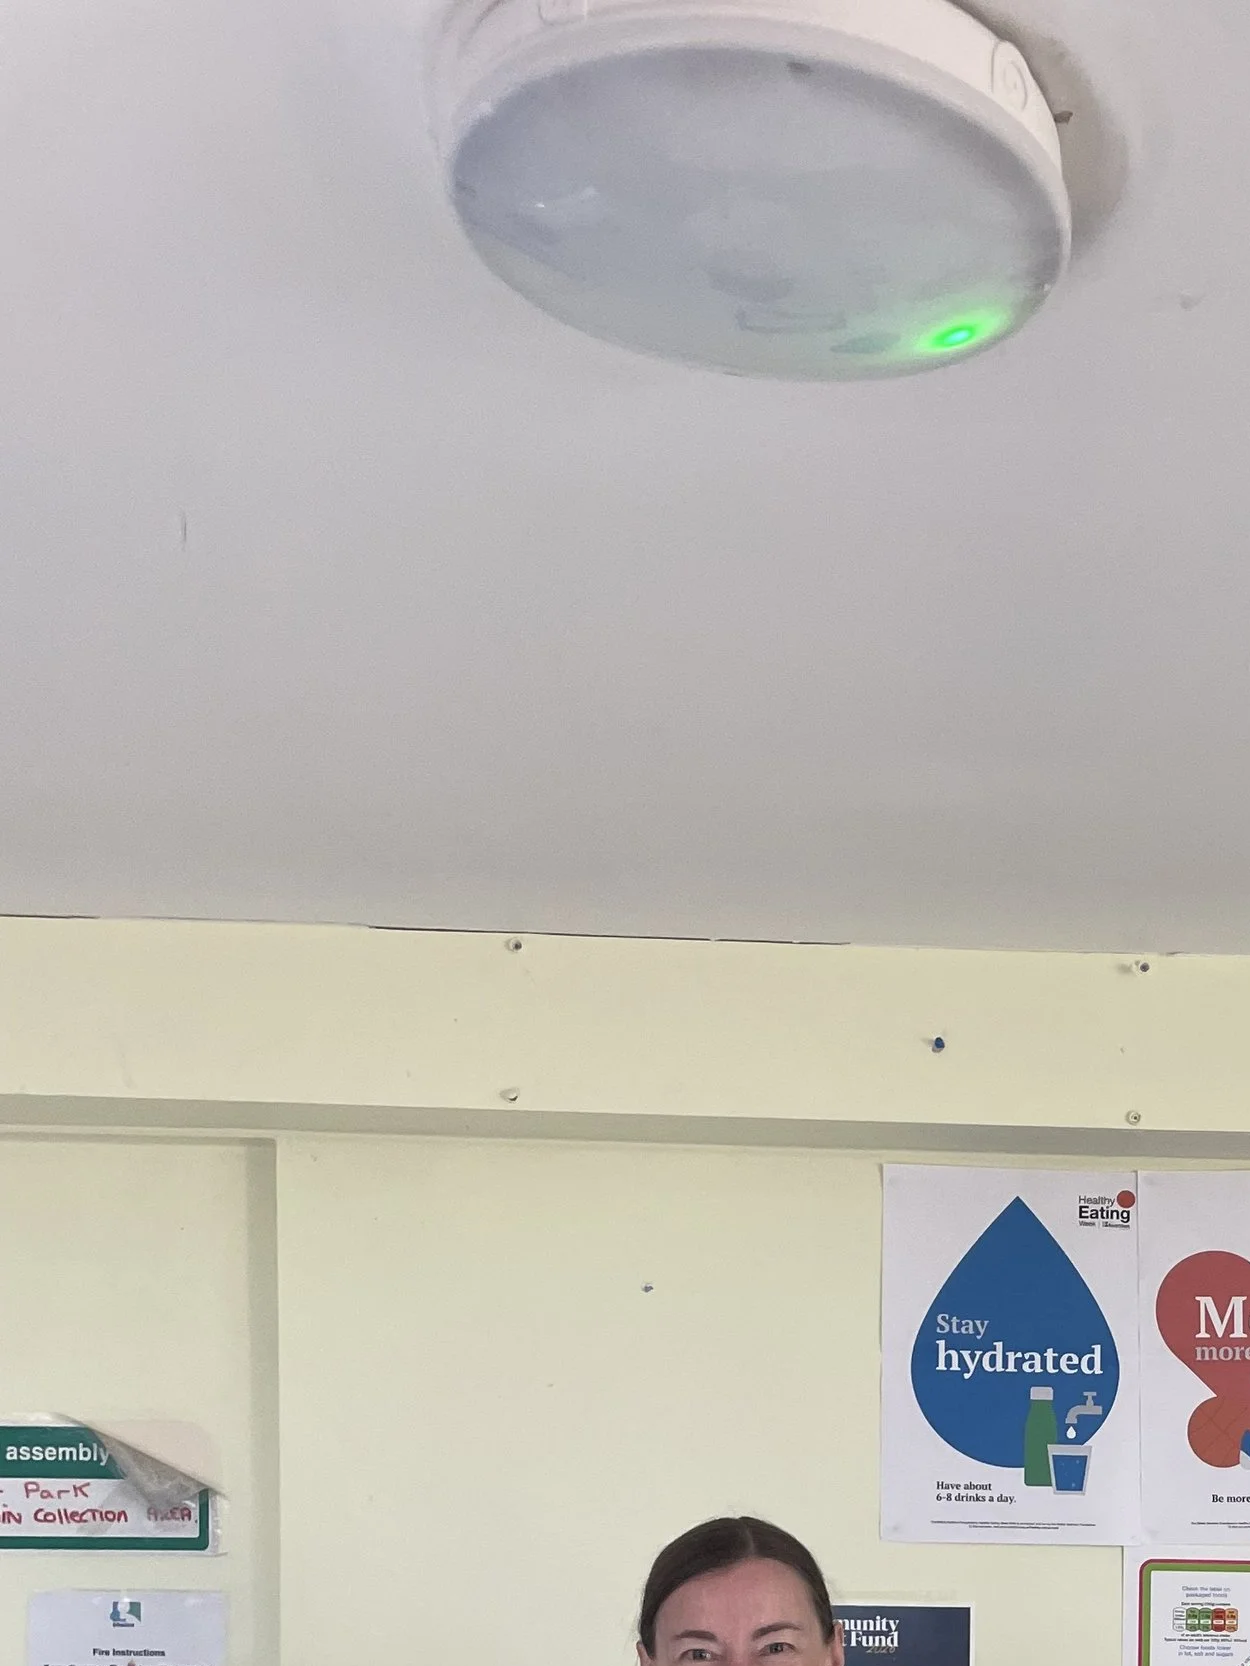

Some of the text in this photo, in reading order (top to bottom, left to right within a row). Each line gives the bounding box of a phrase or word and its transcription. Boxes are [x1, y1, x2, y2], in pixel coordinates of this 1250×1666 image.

[1079, 1195, 1115, 1207] Healthy
[1079, 1205, 1130, 1223] Eating
[936, 1314, 989, 1339] Stay
[936, 1340, 1103, 1379] hydrated
[6, 1443, 110, 1466] assembly
[24, 1481, 90, 1499] Park
[936, 1481, 992, 1491] Have about
[936, 1493, 952, 1502] 6-8
[955, 1493, 986, 1502] drinks
[997, 1494, 1016, 1504] day.
[1212, 1494, 1224, 1503] Be
[34, 1508, 129, 1525] Collection
[850, 1631, 899, 1647] Fund
[92, 1648, 165, 1657] Fire Instructions
